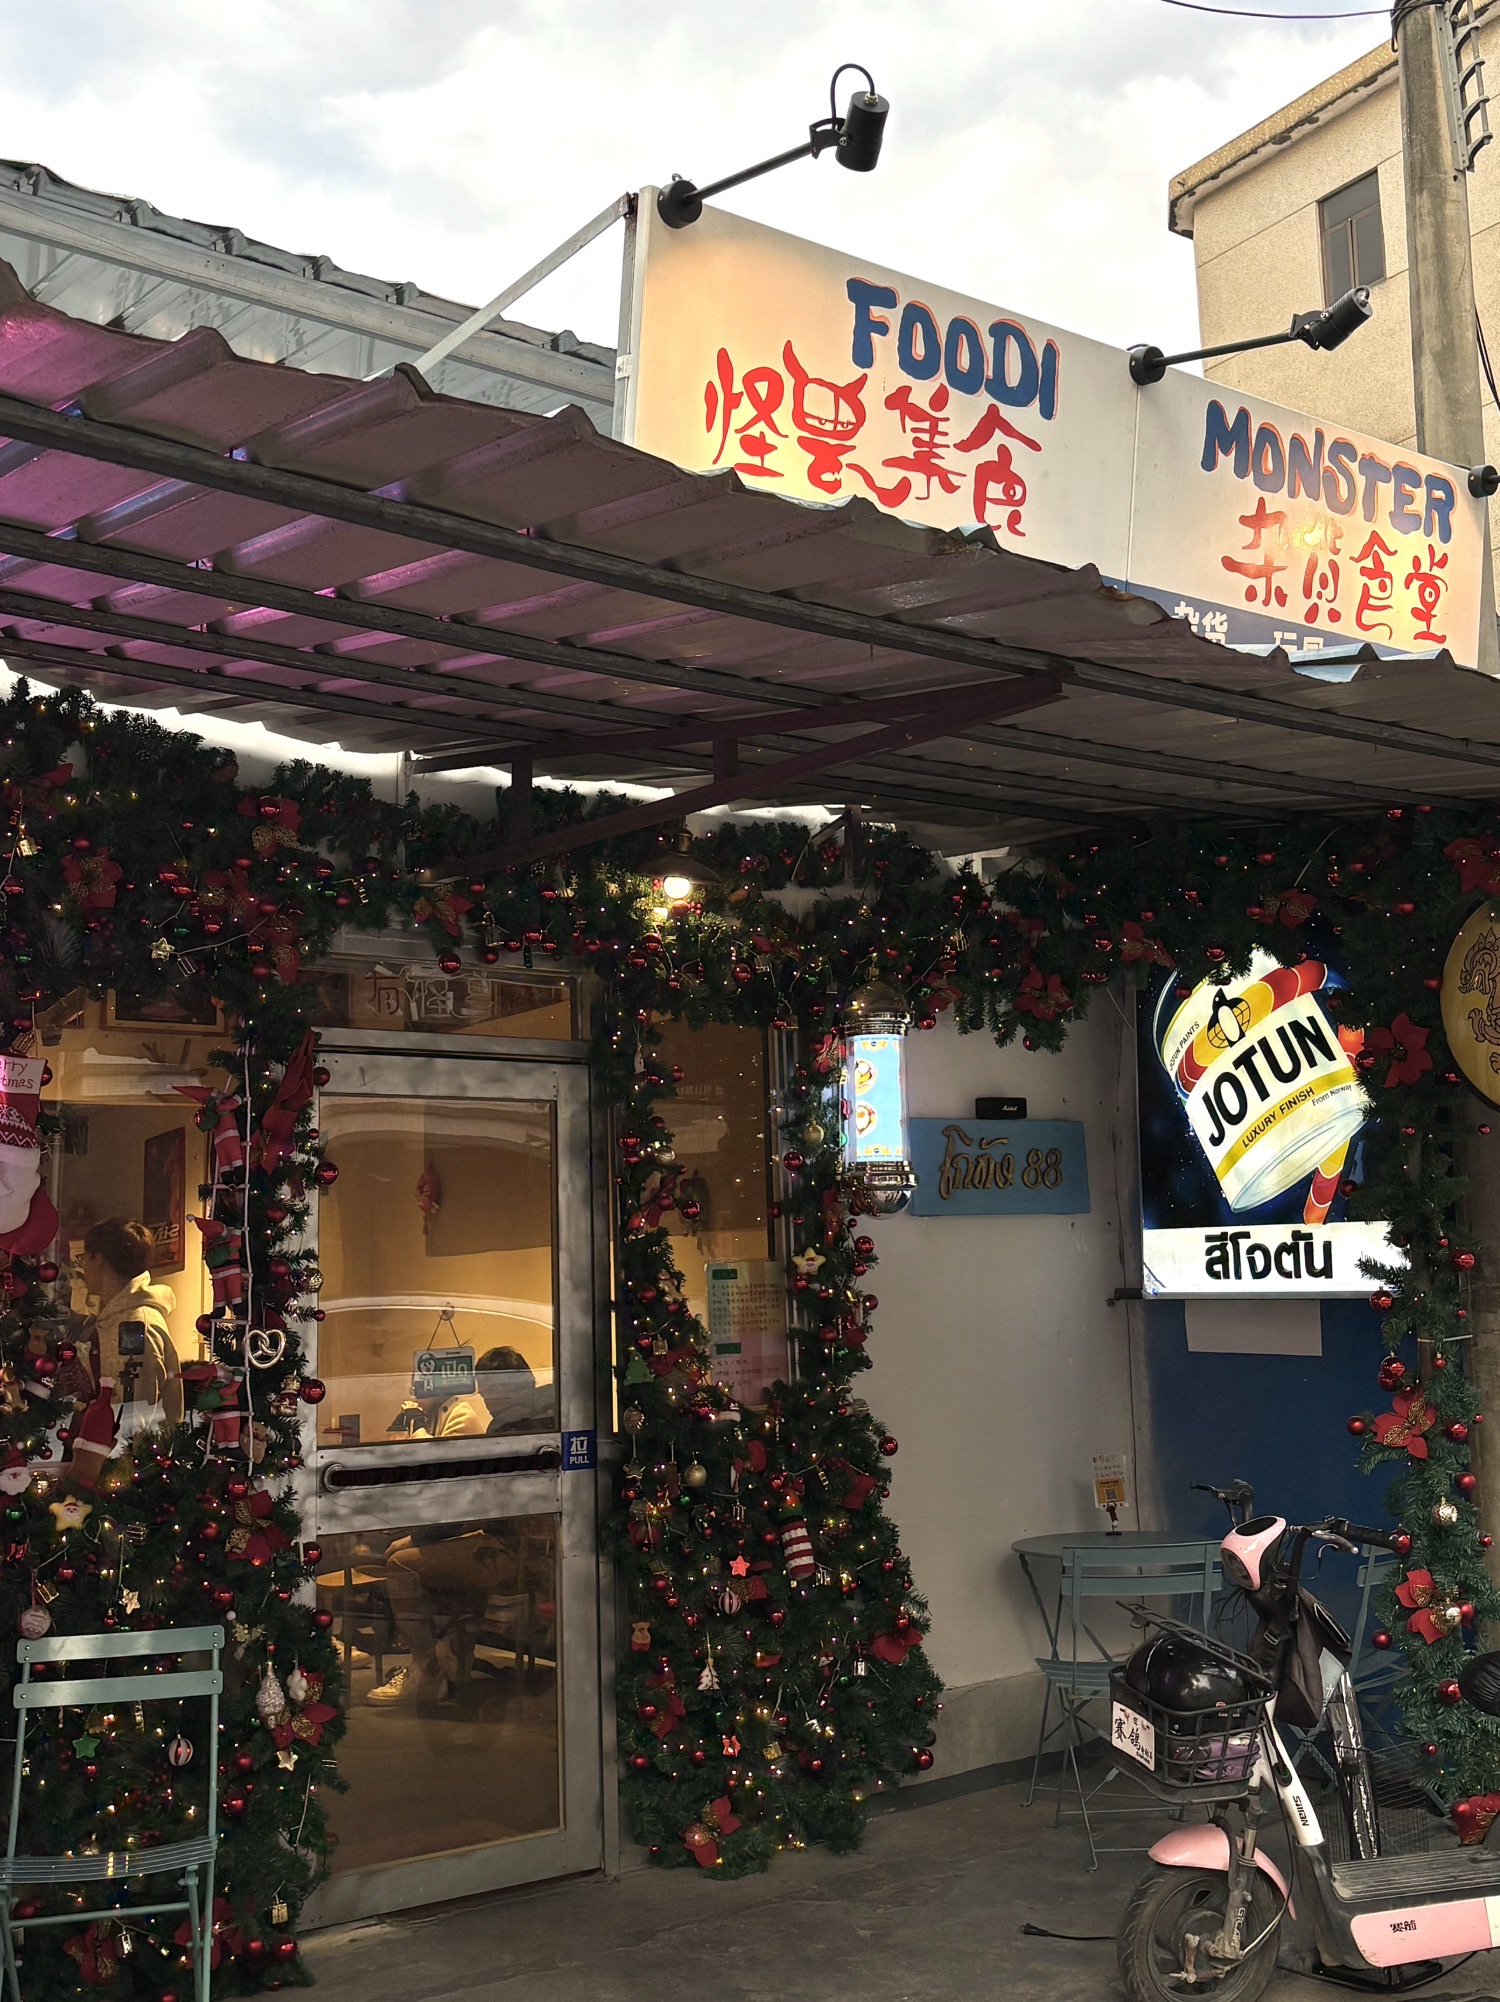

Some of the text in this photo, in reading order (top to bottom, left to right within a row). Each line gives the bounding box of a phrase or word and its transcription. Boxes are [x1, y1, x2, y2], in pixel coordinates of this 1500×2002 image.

[846, 277, 1060, 420] FOODI
[1201, 399, 1457, 544] MONSTER
[1221, 496, 1449, 644] 杂货食堂
[1202, 1015, 1337, 1147] JOTUN
[1312, 1084, 1352, 1106] From Norway
[1242, 1086, 1315, 1148] LUXURY FINISH
[1022, 1147, 1063, 1190] 88
[1205, 1230, 1333, 1280] สีโจตัน
[570, 1436, 588, 1455] 拉
[570, 1455, 590, 1465] PULL
